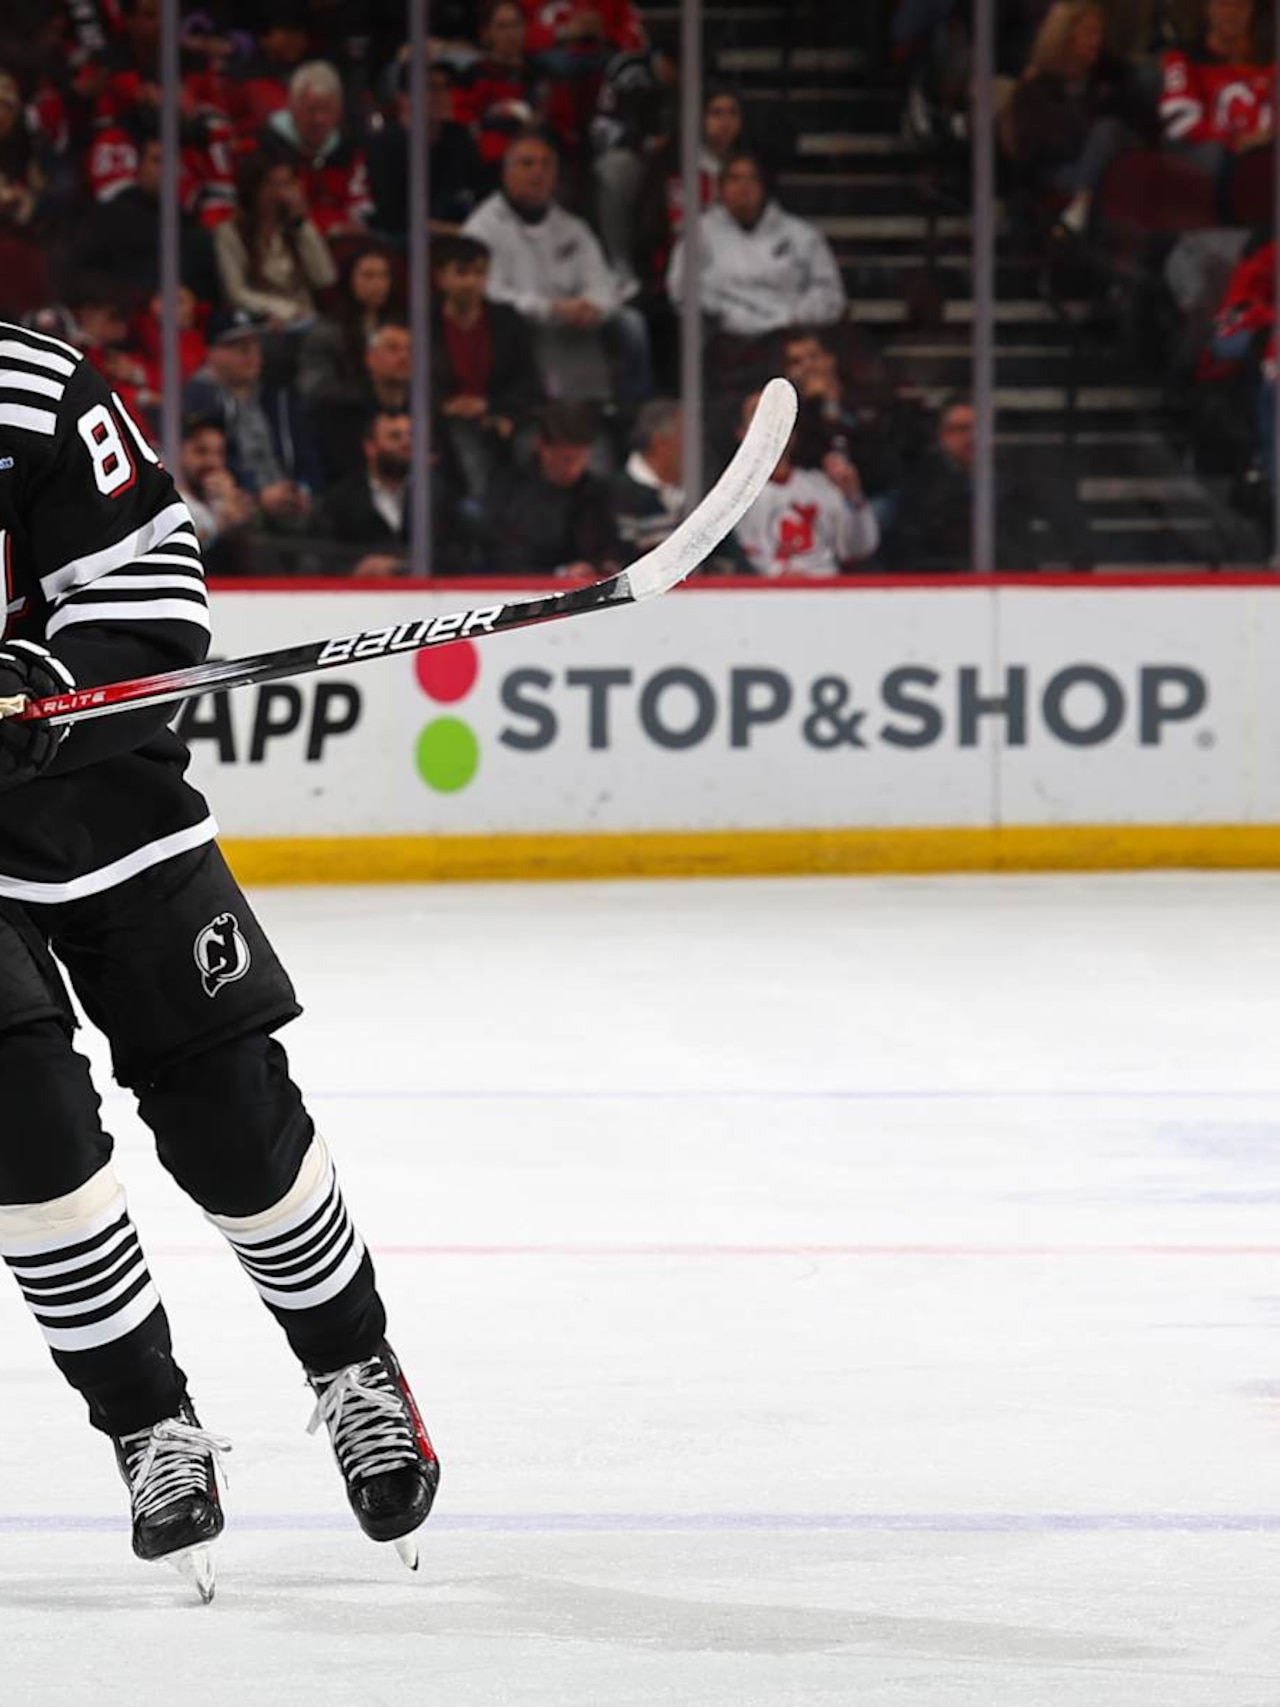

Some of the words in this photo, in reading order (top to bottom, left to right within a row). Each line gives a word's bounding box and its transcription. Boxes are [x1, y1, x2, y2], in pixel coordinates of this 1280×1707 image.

[77, 391, 164, 498] 8
[317, 603, 505, 656] BAUER
[498, 663, 1209, 751] STOP&SHOP
